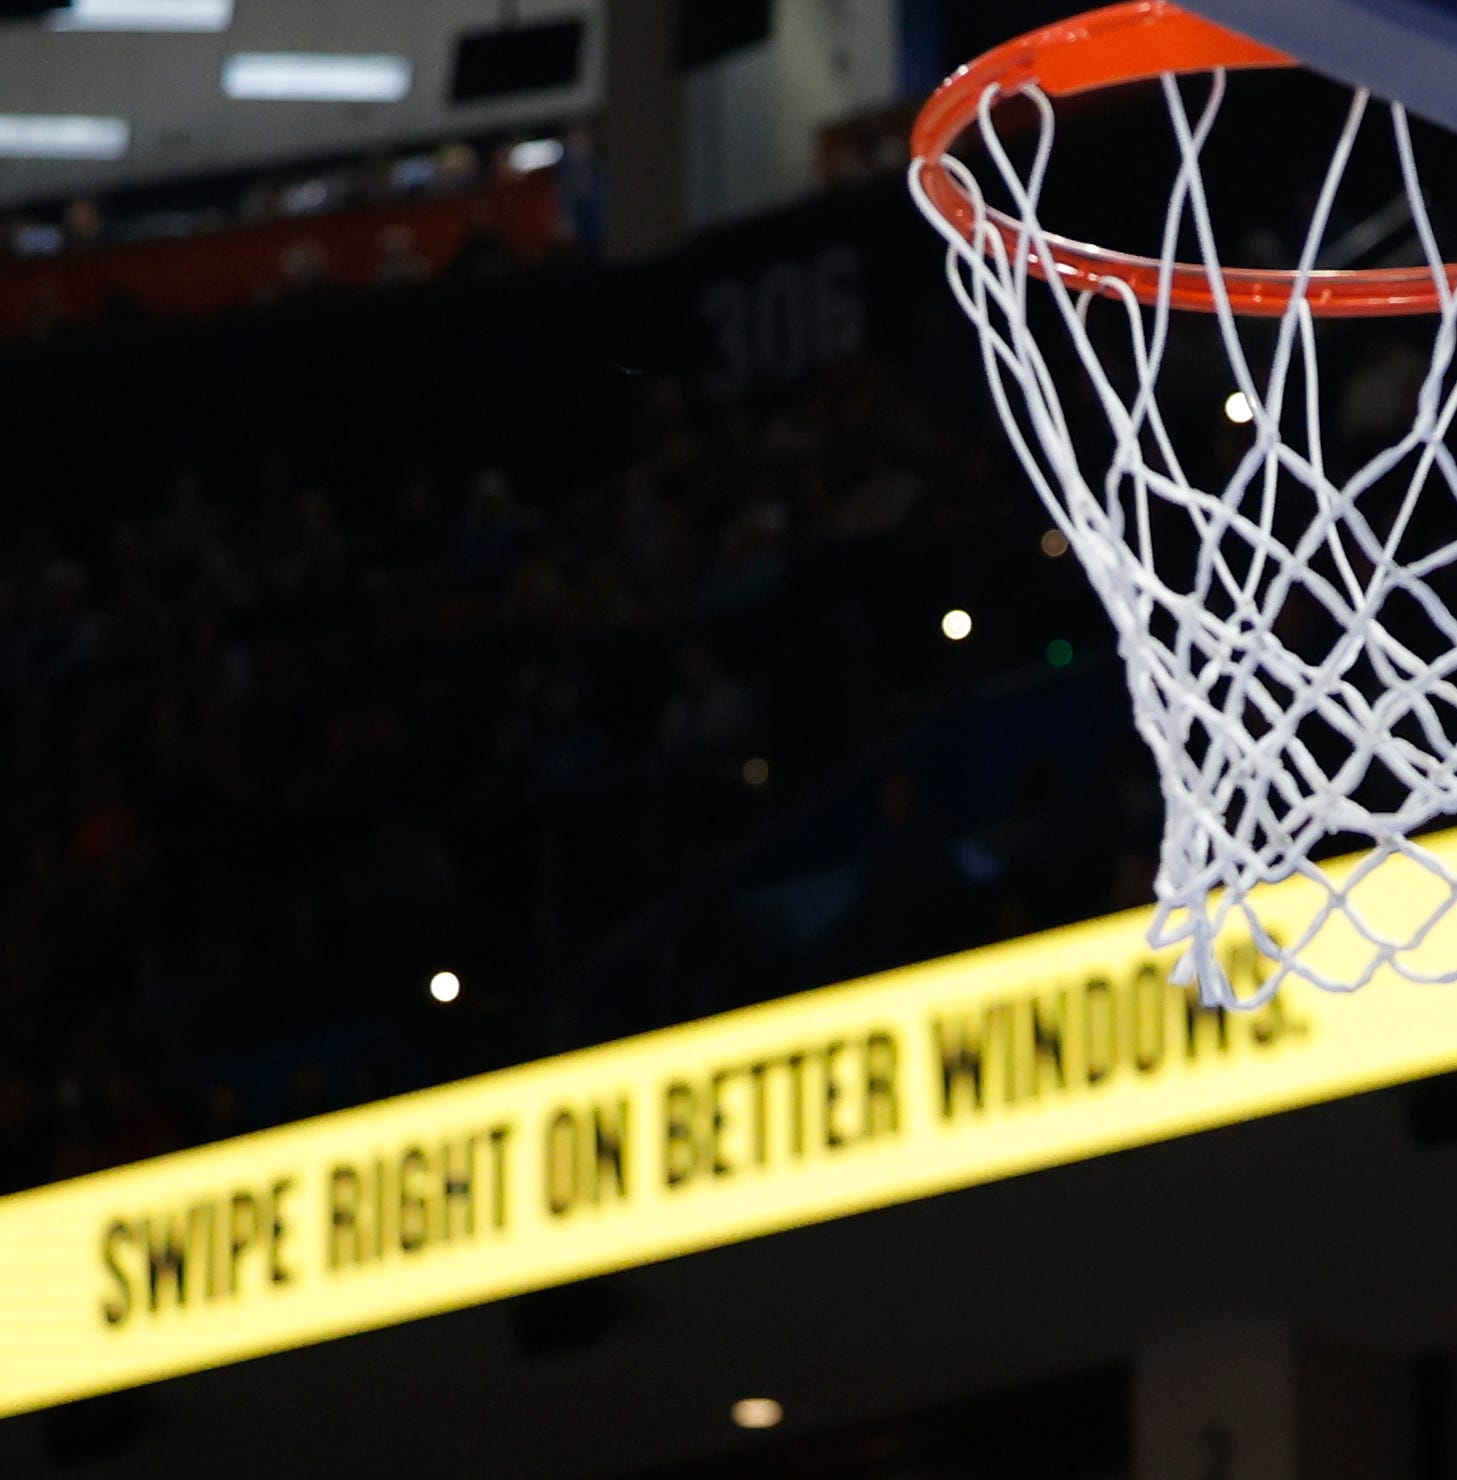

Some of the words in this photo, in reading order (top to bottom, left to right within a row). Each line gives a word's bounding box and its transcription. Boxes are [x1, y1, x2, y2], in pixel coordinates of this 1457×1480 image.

[101, 1170, 298, 1328] SWIPE
[326, 1122, 515, 1275] RIGHT
[545, 1098, 632, 1217] ON
[662, 1027, 898, 1192] BETTER
